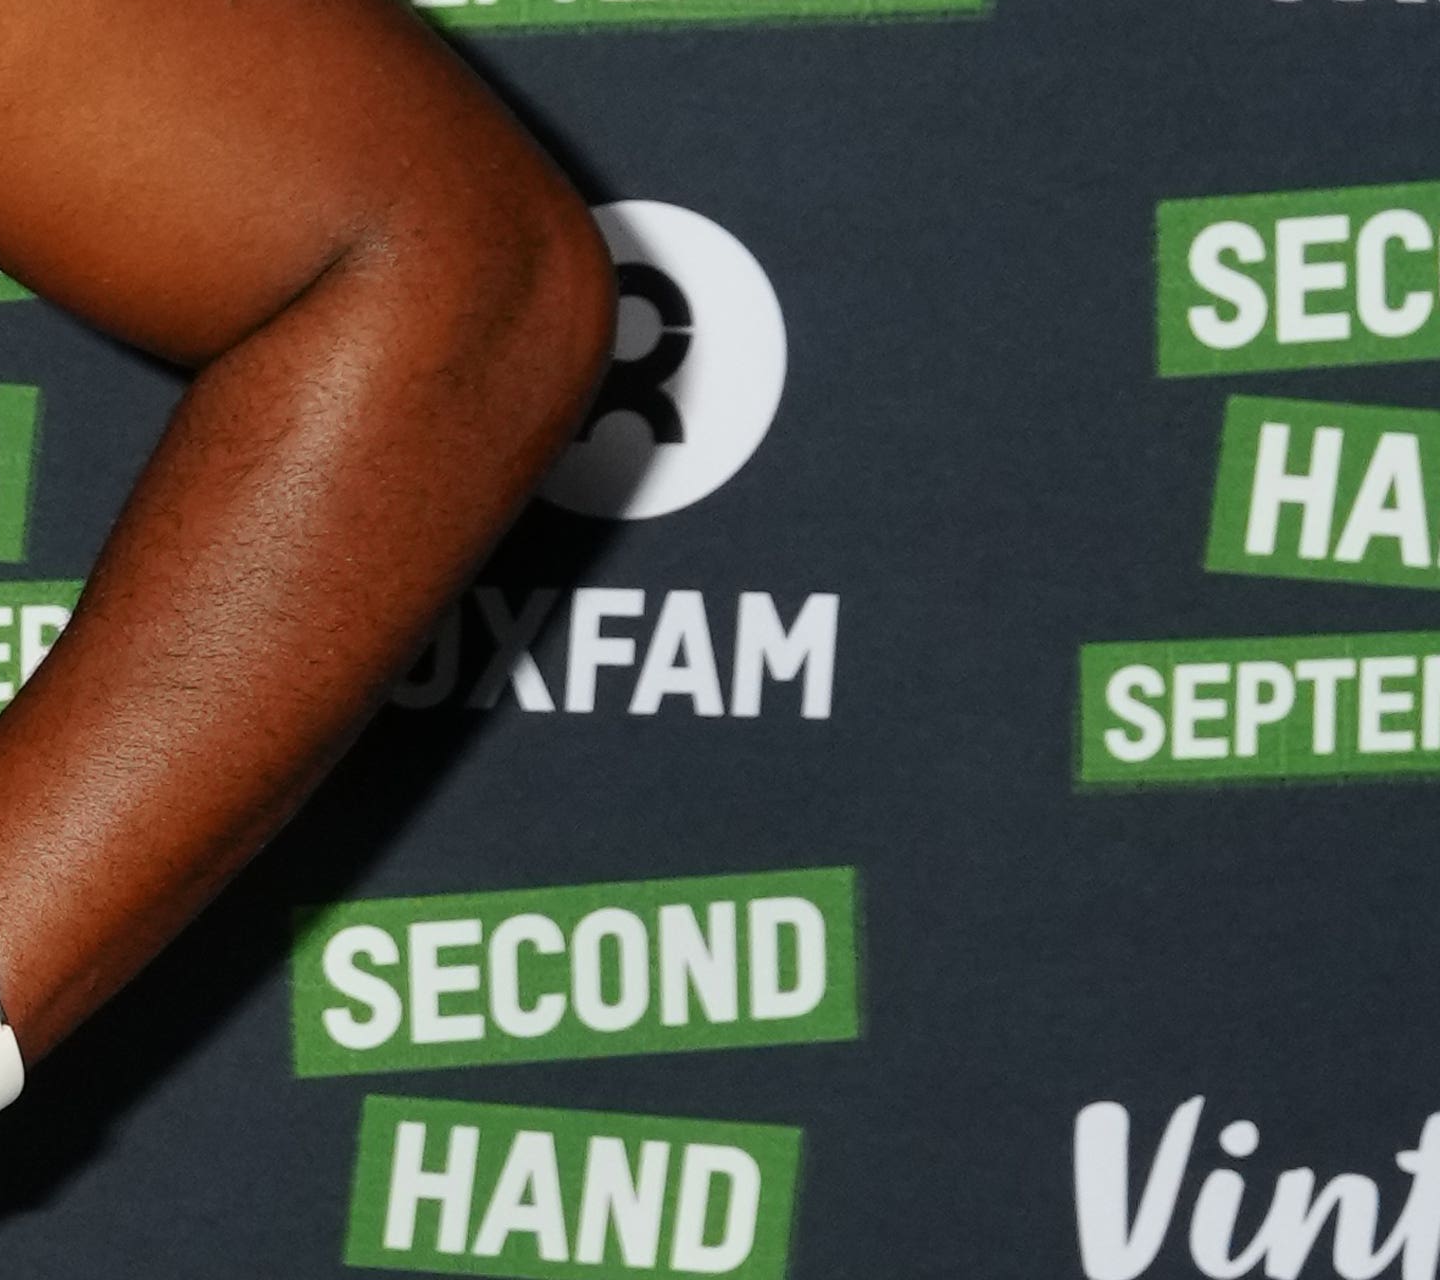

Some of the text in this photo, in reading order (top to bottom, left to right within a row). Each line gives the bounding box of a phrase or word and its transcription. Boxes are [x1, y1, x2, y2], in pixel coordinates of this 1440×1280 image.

[1105, 655, 1440, 761] SEPTE
[323, 897, 826, 1049] SECOND
[385, 1122, 761, 1273] HAND
